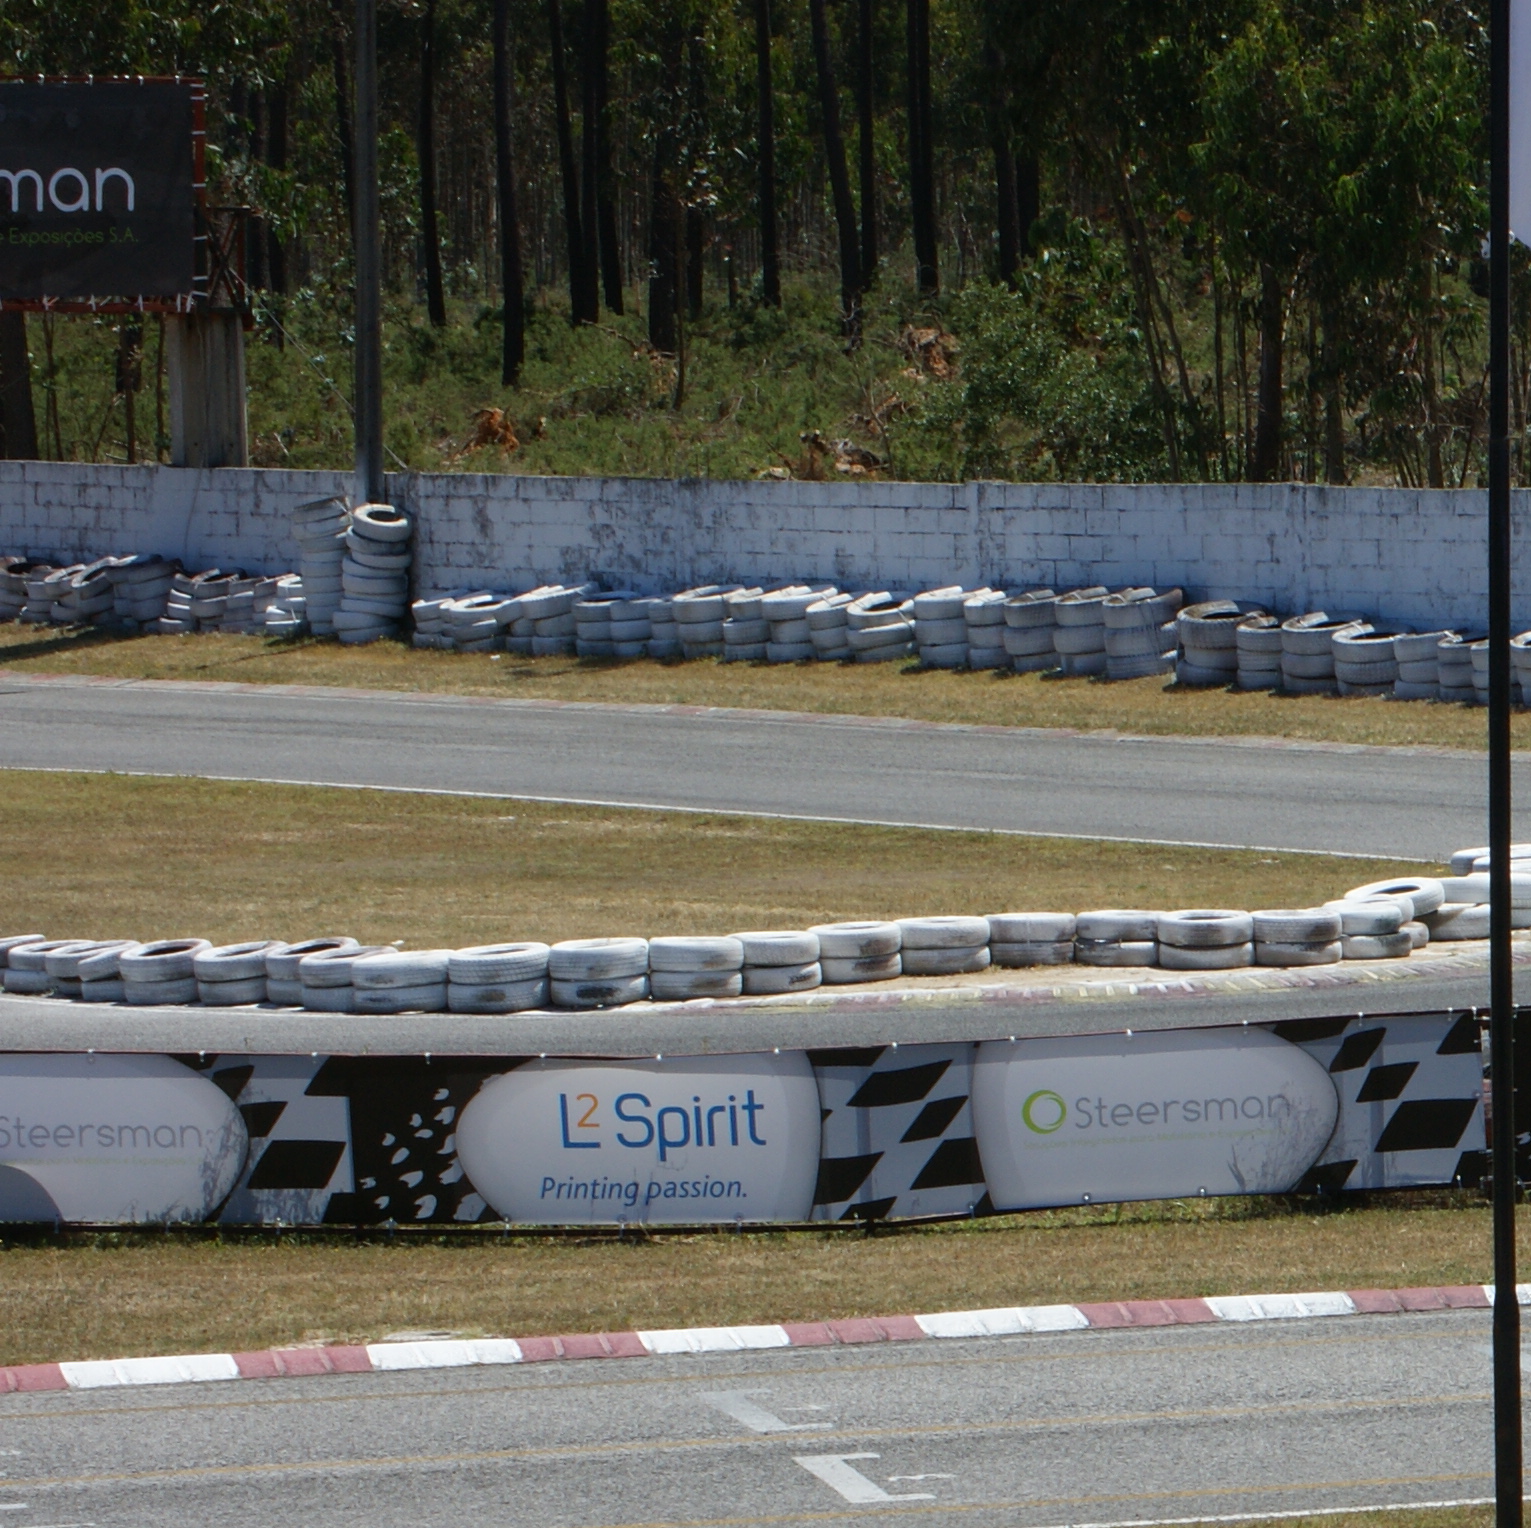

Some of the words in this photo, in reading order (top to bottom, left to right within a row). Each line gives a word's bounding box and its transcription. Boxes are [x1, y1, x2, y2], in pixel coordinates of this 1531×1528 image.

[614, 1089, 767, 1162] Spirit
[1074, 1093, 1291, 1129] Steersman
[0, 1115, 202, 1149] Steersman
[540, 1176, 639, 1207] Printing
[645, 1175, 748, 1205] passion.
